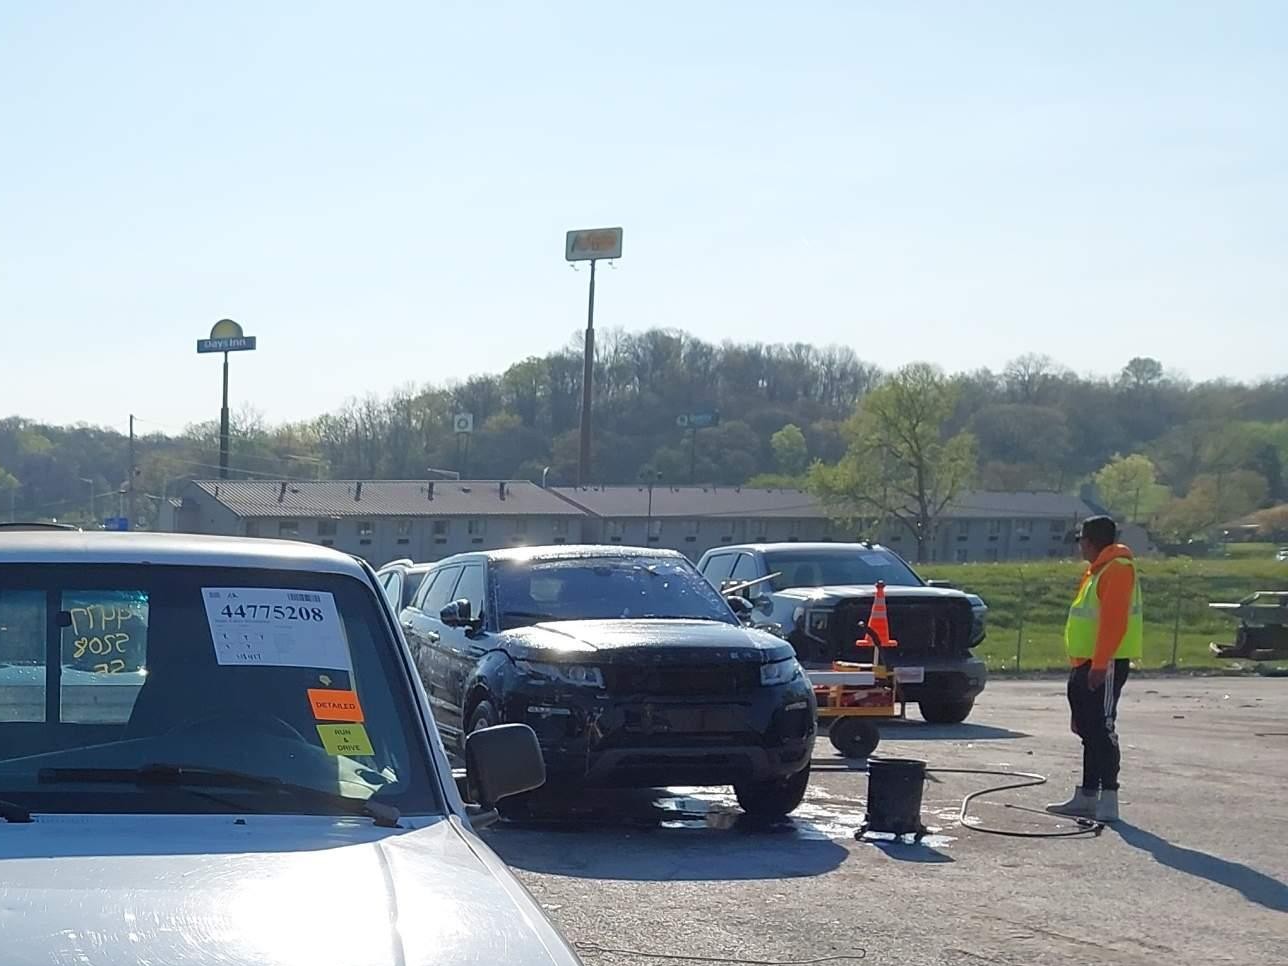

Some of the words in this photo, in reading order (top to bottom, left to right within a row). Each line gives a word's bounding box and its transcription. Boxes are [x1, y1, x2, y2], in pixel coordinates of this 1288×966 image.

[221, 604, 324, 622] 44775208
[316, 701, 356, 710] DETAILED
[334, 728, 352, 736] RUN
[337, 744, 361, 752] DRIVE
